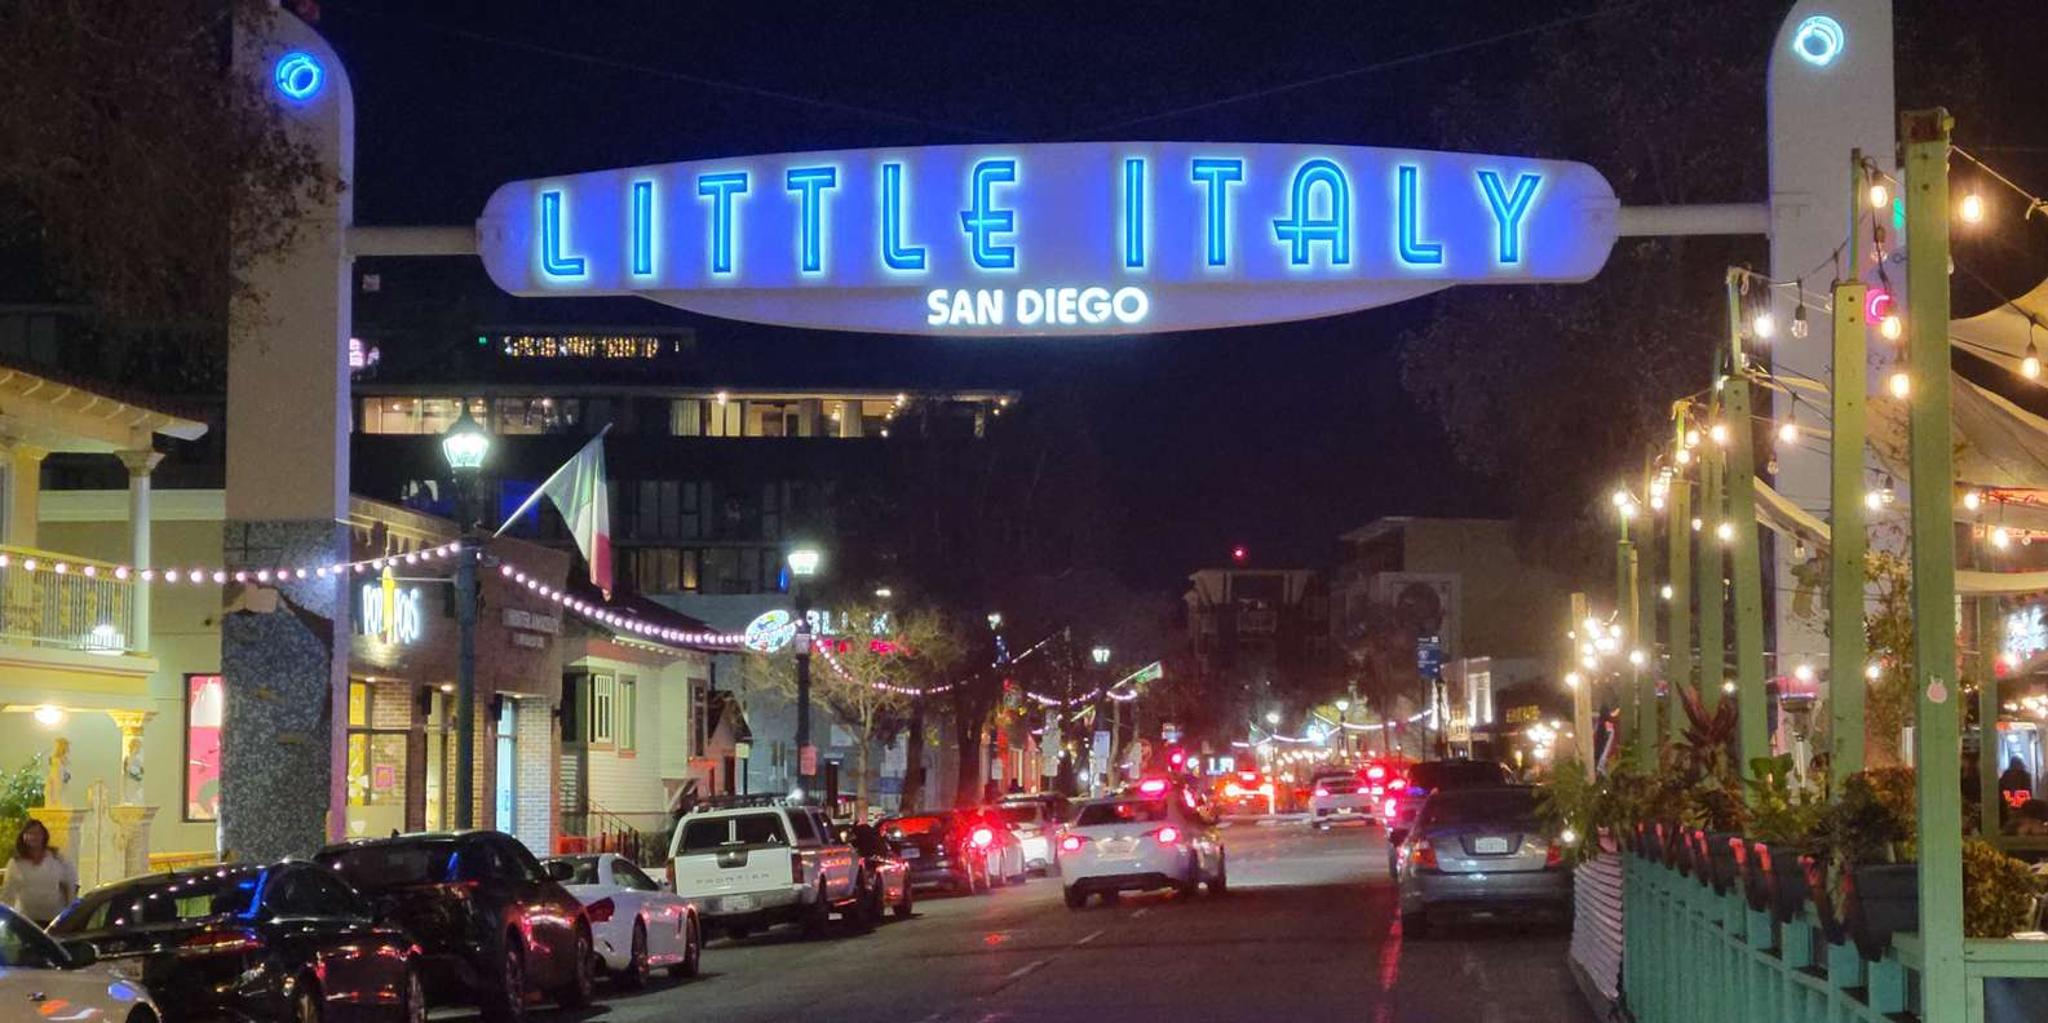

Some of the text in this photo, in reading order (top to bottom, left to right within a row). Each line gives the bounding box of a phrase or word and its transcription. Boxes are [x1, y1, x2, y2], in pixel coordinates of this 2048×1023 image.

[540, 158, 1542, 277] LITTLE ITALY
[926, 286, 1149, 326] SAN DIEGO
